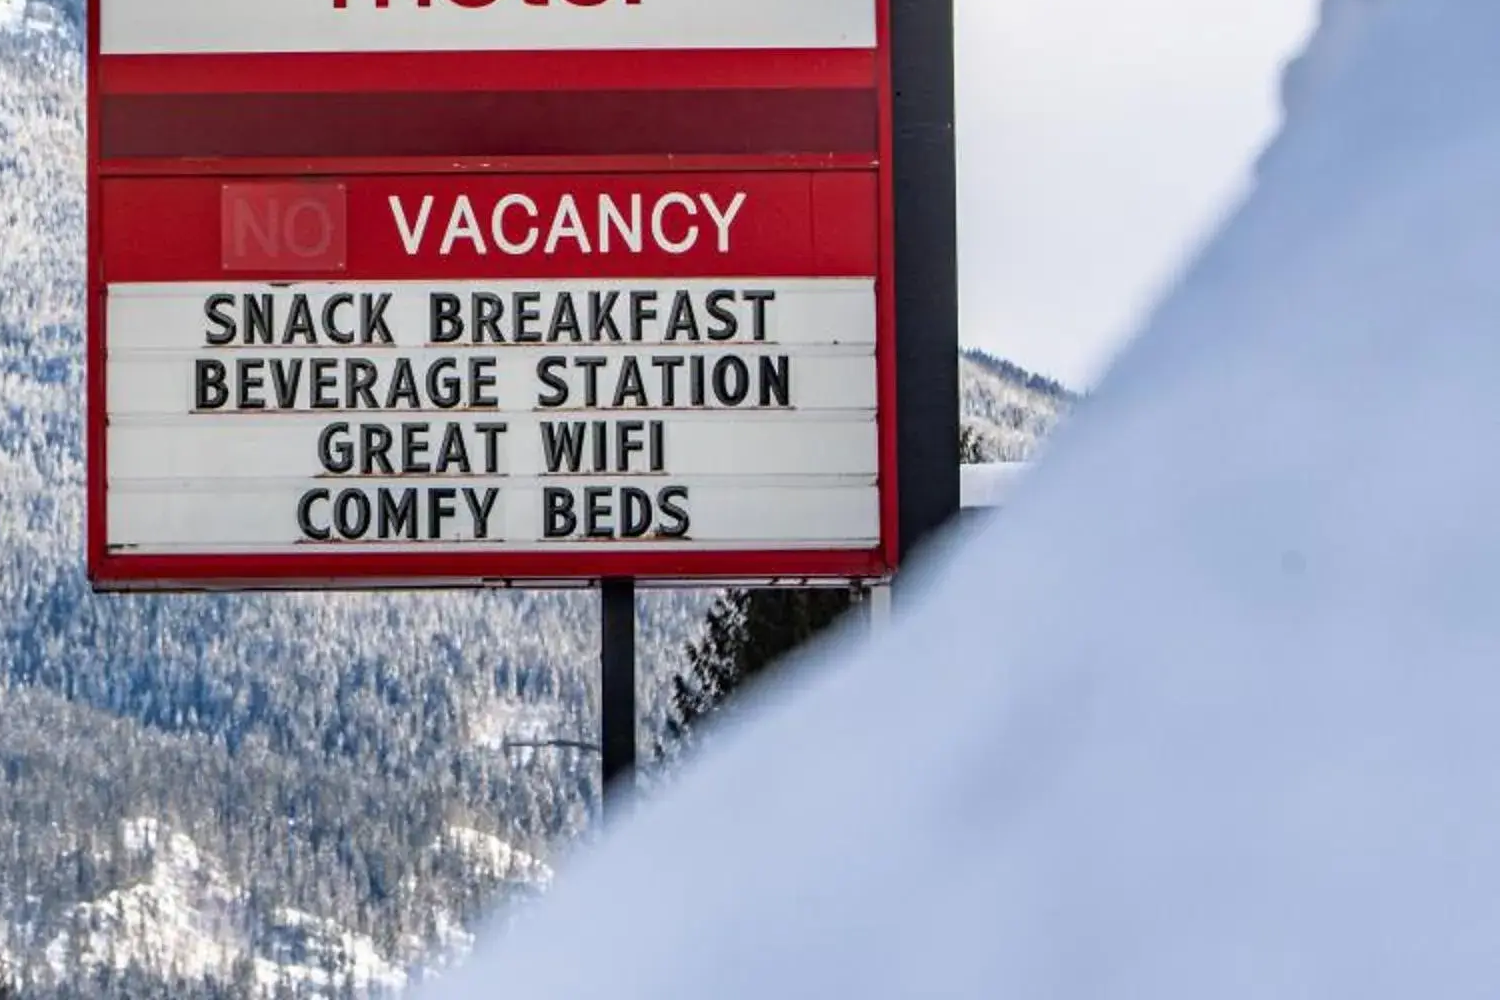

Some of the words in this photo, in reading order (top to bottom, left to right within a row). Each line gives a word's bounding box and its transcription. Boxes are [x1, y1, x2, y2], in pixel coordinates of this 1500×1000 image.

[231, 199, 332, 258] NO
[388, 191, 747, 256] VACANCY
[204, 292, 394, 345] SNACK
[429, 289, 775, 343] BREAKFAST
[195, 356, 498, 409] BEVERAGE
[536, 354, 791, 407] STATION
[317, 421, 506, 474] GREAT
[541, 420, 665, 472] WIFI
[298, 487, 499, 540] COMFY
[543, 485, 690, 538] BEDS
